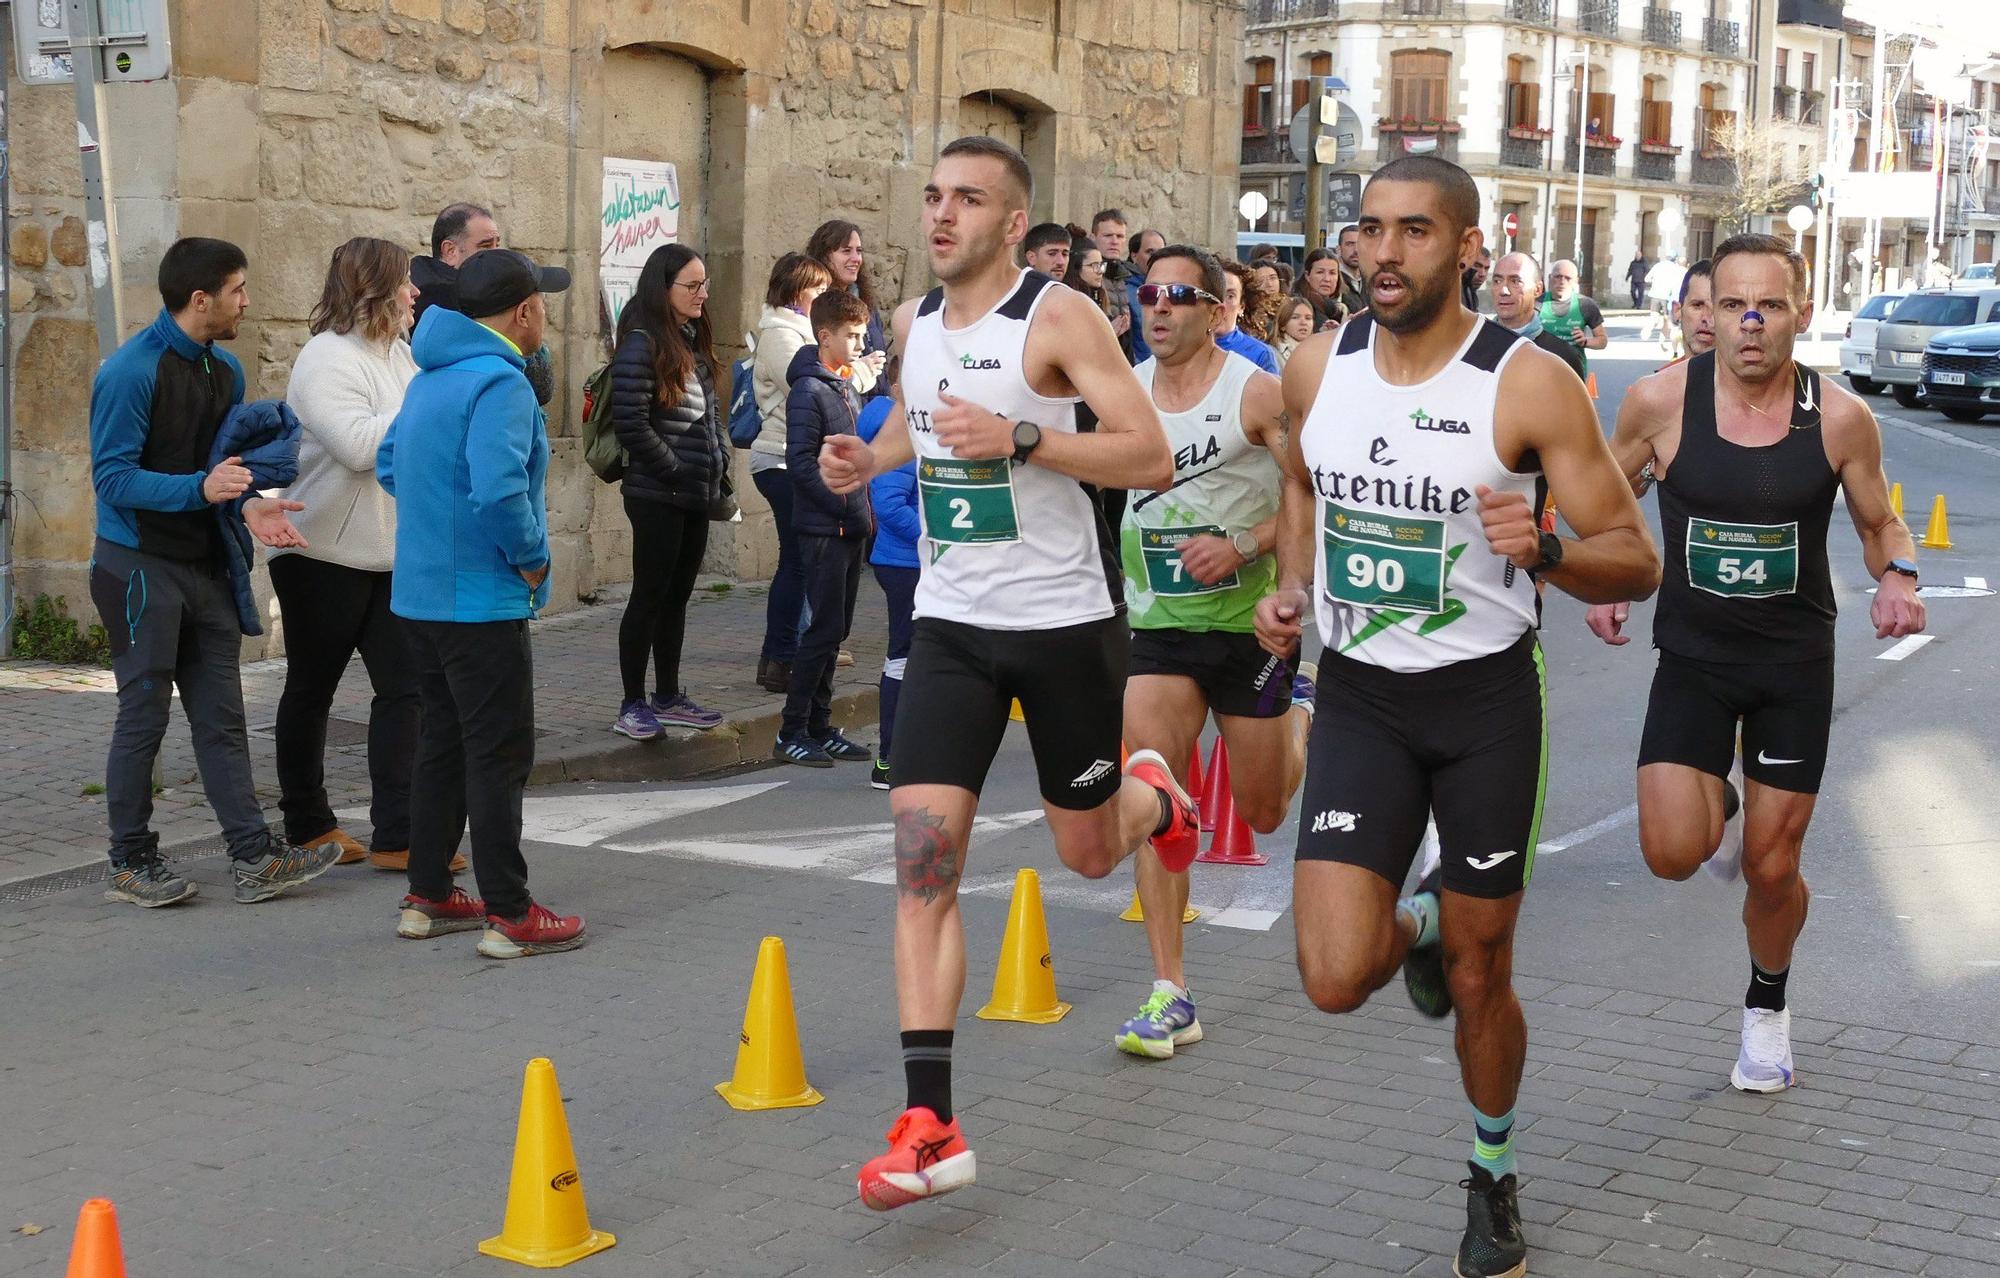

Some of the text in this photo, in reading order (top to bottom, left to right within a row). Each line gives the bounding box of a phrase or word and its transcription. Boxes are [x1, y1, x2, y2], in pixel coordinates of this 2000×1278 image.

[963, 359, 1001, 369] LUGA
[1415, 417, 1471, 434] LUGA
[1307, 464, 1472, 514] txenike
[949, 498, 974, 528] 2
[1348, 524, 1359, 532] DE
[1349, 519, 1367, 527] CAJA
[1395, 533, 1423, 541] SOCIAL
[1166, 559, 1184, 583] 7
[1347, 553, 1404, 593] 90
[1717, 558, 1767, 585] 54
[1070, 780, 1095, 788] NIKE
